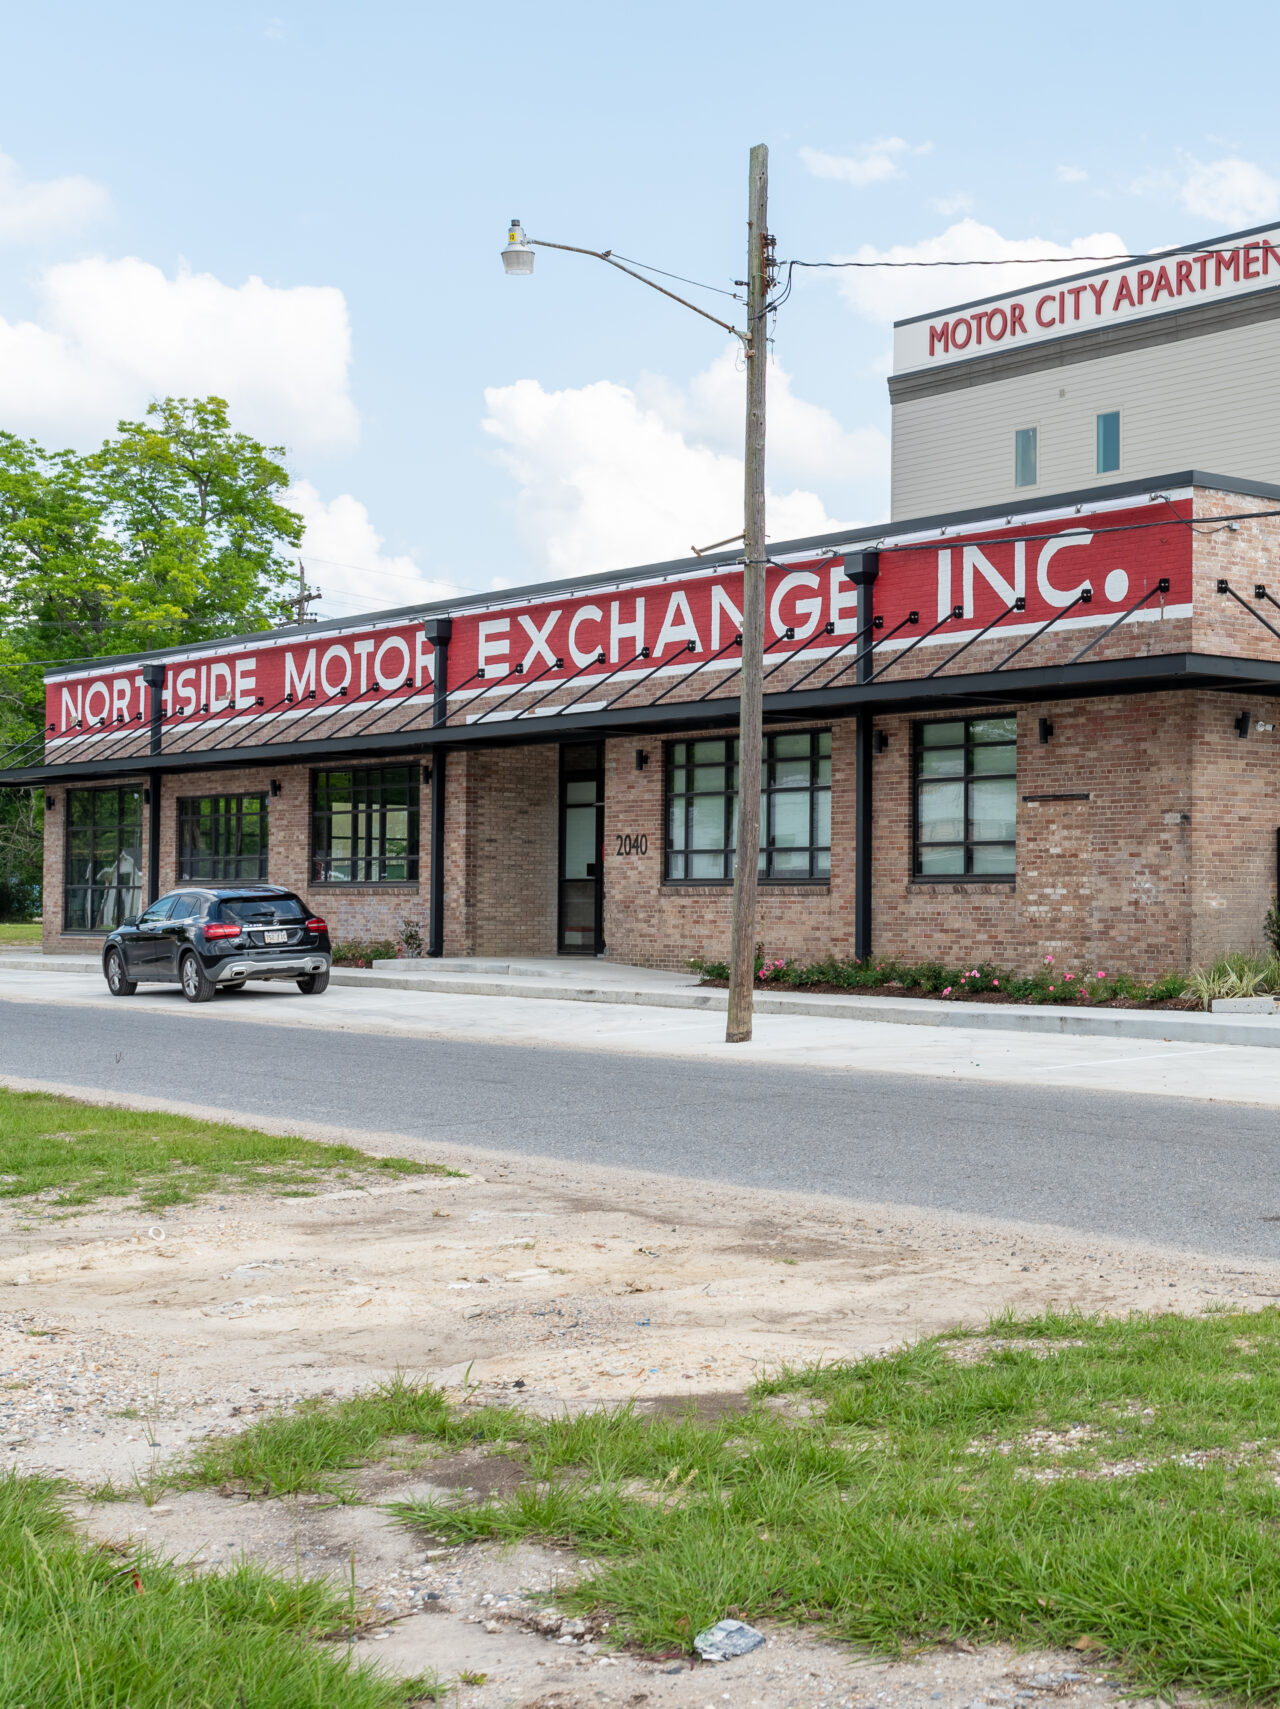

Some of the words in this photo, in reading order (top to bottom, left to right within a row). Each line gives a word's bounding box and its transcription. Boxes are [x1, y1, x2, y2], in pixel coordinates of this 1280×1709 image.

[928, 303, 1027, 356] MOTOR
[1035, 279, 1109, 328] CITY
[61, 657, 257, 732] NORTHSIDE
[284, 631, 435, 704] MOTOR
[478, 565, 857, 679] EXCHANGE
[937, 528, 1129, 623] INC.
[616, 833, 648, 856] 2040
